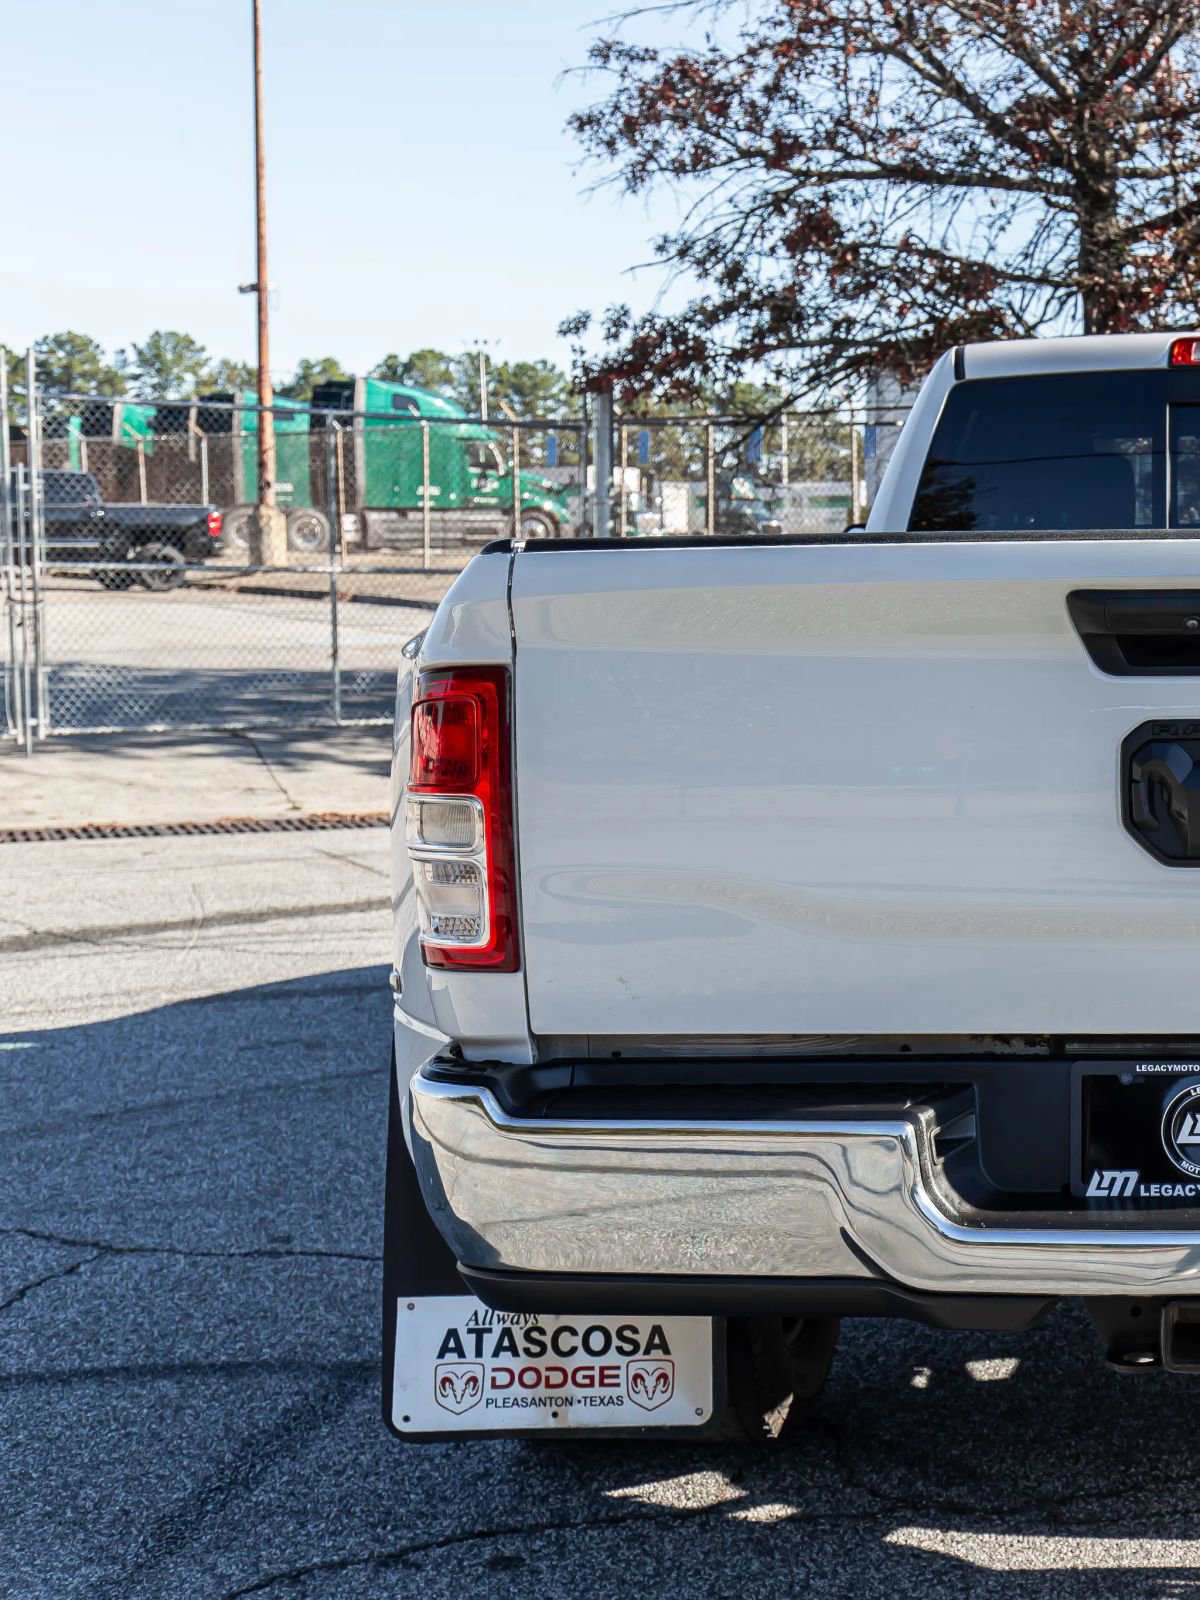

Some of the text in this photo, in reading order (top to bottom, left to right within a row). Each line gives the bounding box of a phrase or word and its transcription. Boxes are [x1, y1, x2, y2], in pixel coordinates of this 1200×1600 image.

[464, 1309, 540, 1330] Allways
[436, 1324, 672, 1359] ATASCOSA
[490, 1365, 622, 1390] DODGE
[485, 1396, 574, 1409] PLEASANTON
